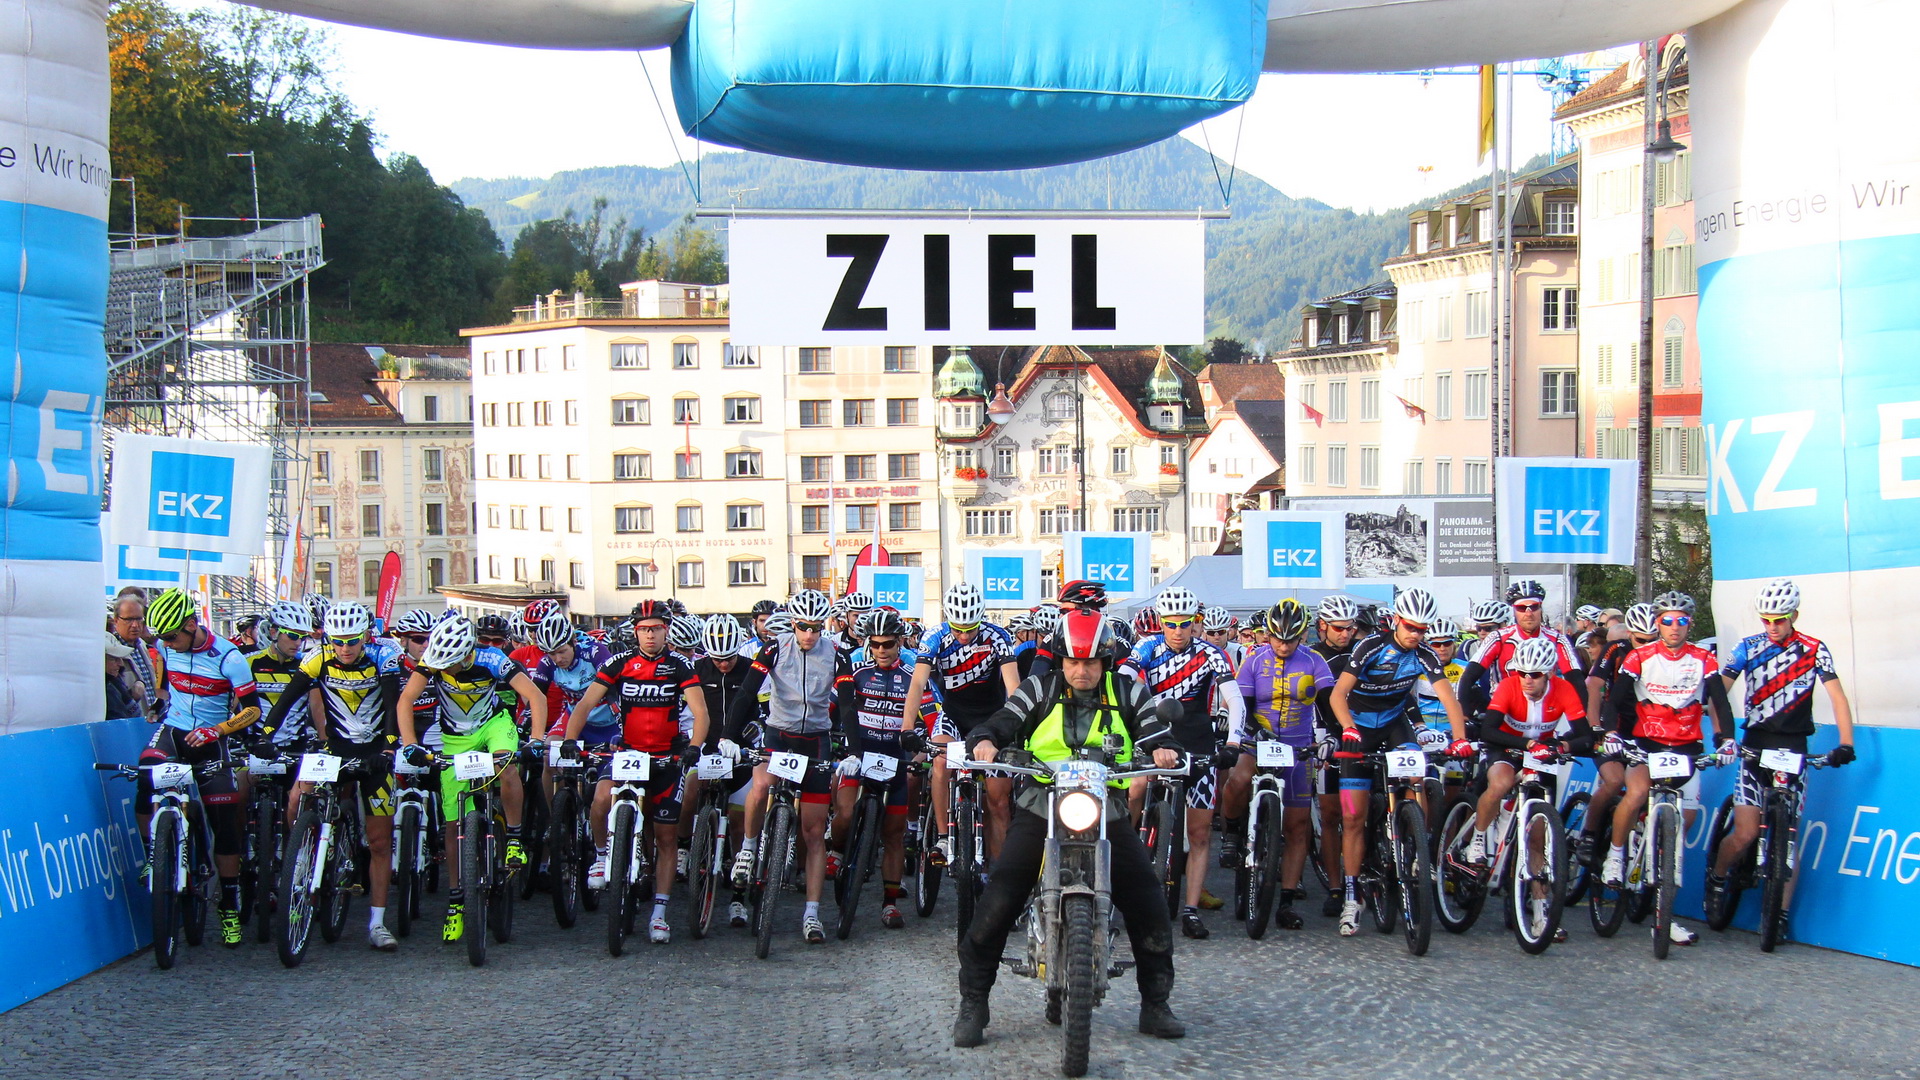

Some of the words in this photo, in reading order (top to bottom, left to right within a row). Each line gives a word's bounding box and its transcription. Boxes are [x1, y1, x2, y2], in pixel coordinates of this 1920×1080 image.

[34, 142, 72, 180] Wir
[1733, 188, 1827, 227] Energie
[1851, 179, 1910, 209] Wir
[821, 234, 1117, 331] ZIEL
[1701, 409, 1818, 517] KZ
[1033, 480, 1093, 493] RATHUS
[157, 490, 224, 520] EKZ
[1439, 517, 1483, 526] PANORAMA
[1533, 508, 1601, 537] EKZ
[1439, 527, 1452, 536] DIE
[1454, 527, 1492, 536] KREUZIGU
[637, 540, 701, 549] RESTAURANT
[705, 539, 736, 547] HOTEL
[741, 538, 773, 546] SONNE
[823, 538, 867, 548] CAPEAU
[879, 537, 904, 546] OUGE
[1273, 549, 1317, 567] EKZ
[1087, 564, 1130, 581] EKZ
[986, 577, 1020, 592] EKZ
[876, 591, 906, 604] EKZ
[605, 649, 633, 668] BMC
[669, 650, 696, 670] BMC
[621, 682, 677, 697] BMC
[864, 698, 905, 712] BMC
[1270, 746, 1283, 754] 18
[316, 759, 324, 768] 4
[468, 754, 479, 763] 11
[621, 759, 641, 770] 24
[710, 758, 722, 766] 16
[876, 759, 884, 768] 6
[1397, 756, 1416, 767] 26
[1658, 756, 1679, 767] 28
[164, 765, 180, 774] 22
[34, 814, 130, 901] bringen
